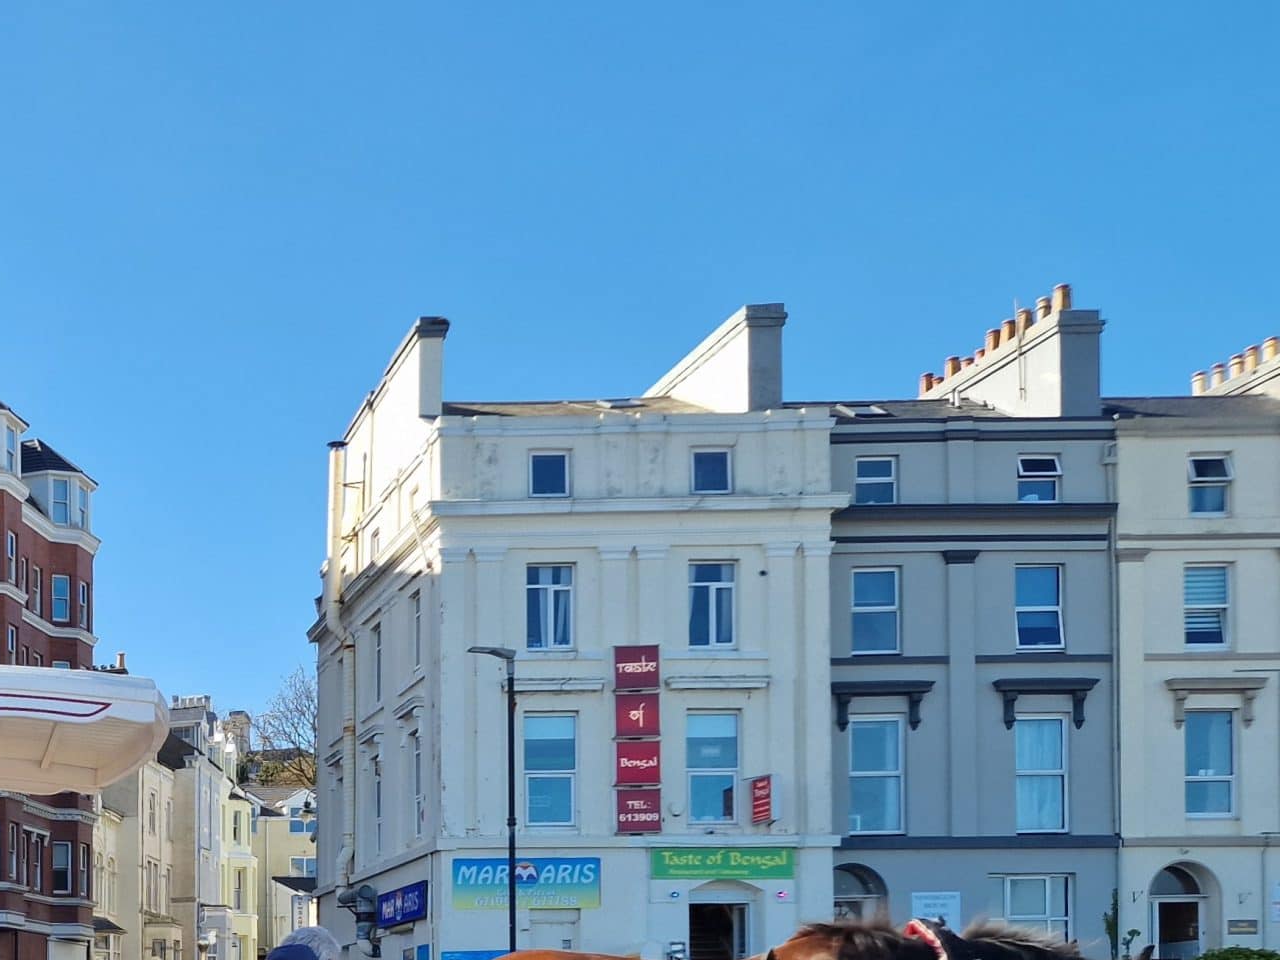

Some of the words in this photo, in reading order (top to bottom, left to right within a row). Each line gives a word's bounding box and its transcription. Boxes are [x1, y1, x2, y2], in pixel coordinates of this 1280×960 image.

[616, 655, 657, 673] Taste
[628, 702, 646, 728] of
[619, 757, 658, 770] Bengal
[661, 850, 702, 865] Taste
[706, 849, 726, 865] of
[729, 848, 787, 869] Bengal
